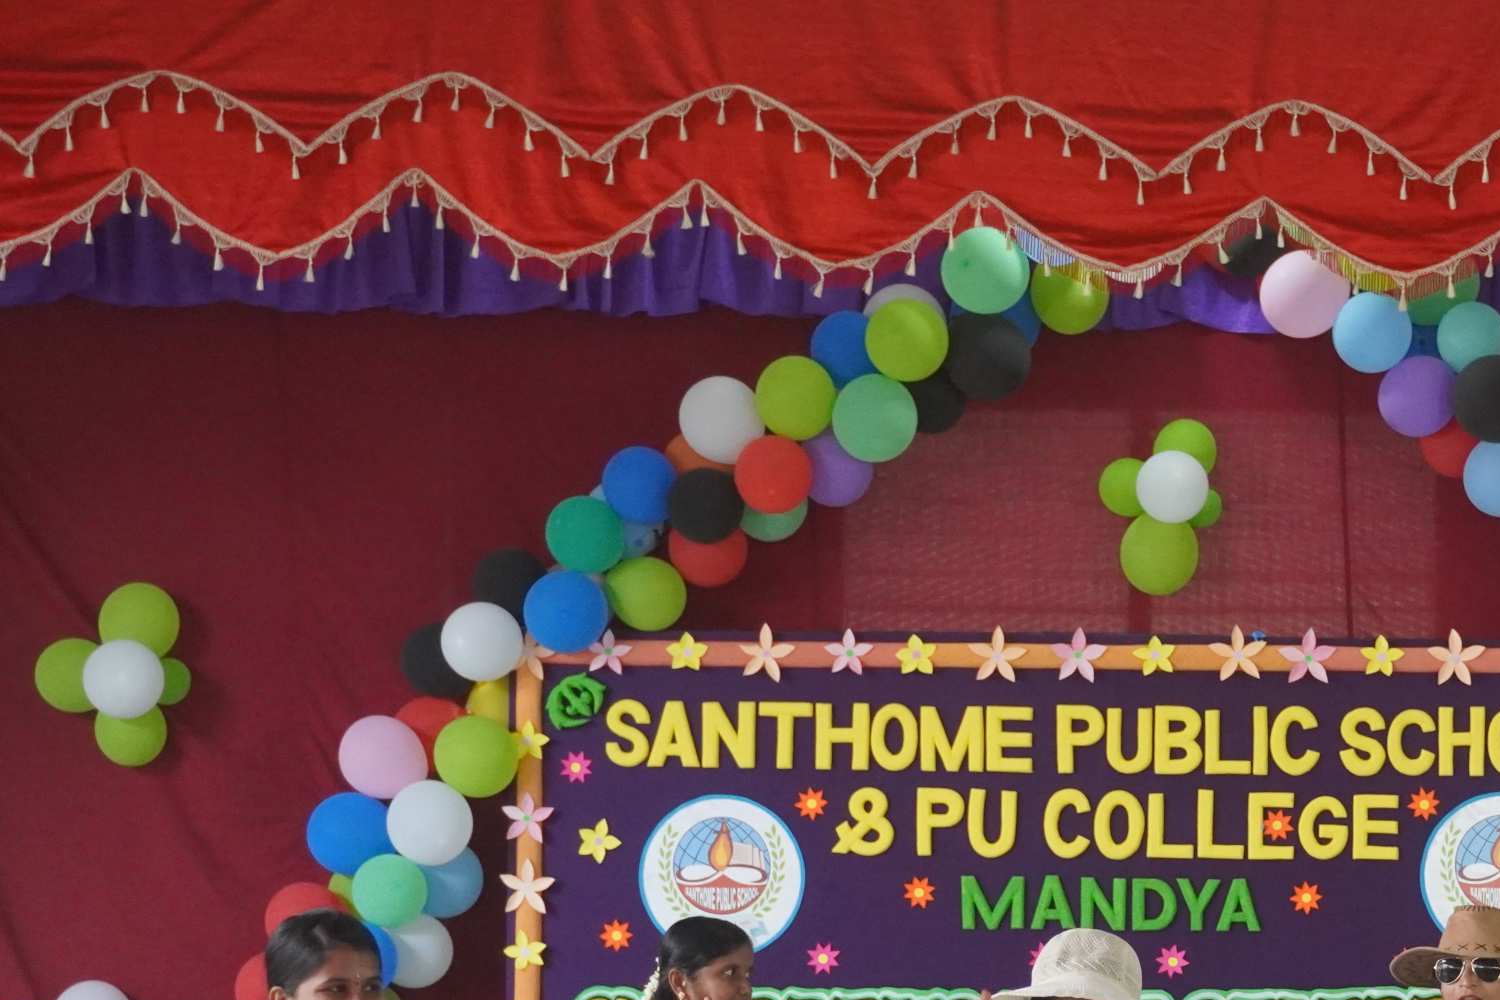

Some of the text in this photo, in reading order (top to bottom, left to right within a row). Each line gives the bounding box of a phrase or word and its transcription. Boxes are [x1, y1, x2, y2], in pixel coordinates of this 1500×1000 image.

[604, 699, 1034, 773] SANTHOME
[1055, 704, 1321, 776] PUBLIC
[832, 786, 1400, 861] & PU COLLEGE
[959, 874, 1261, 933] MANDYA
